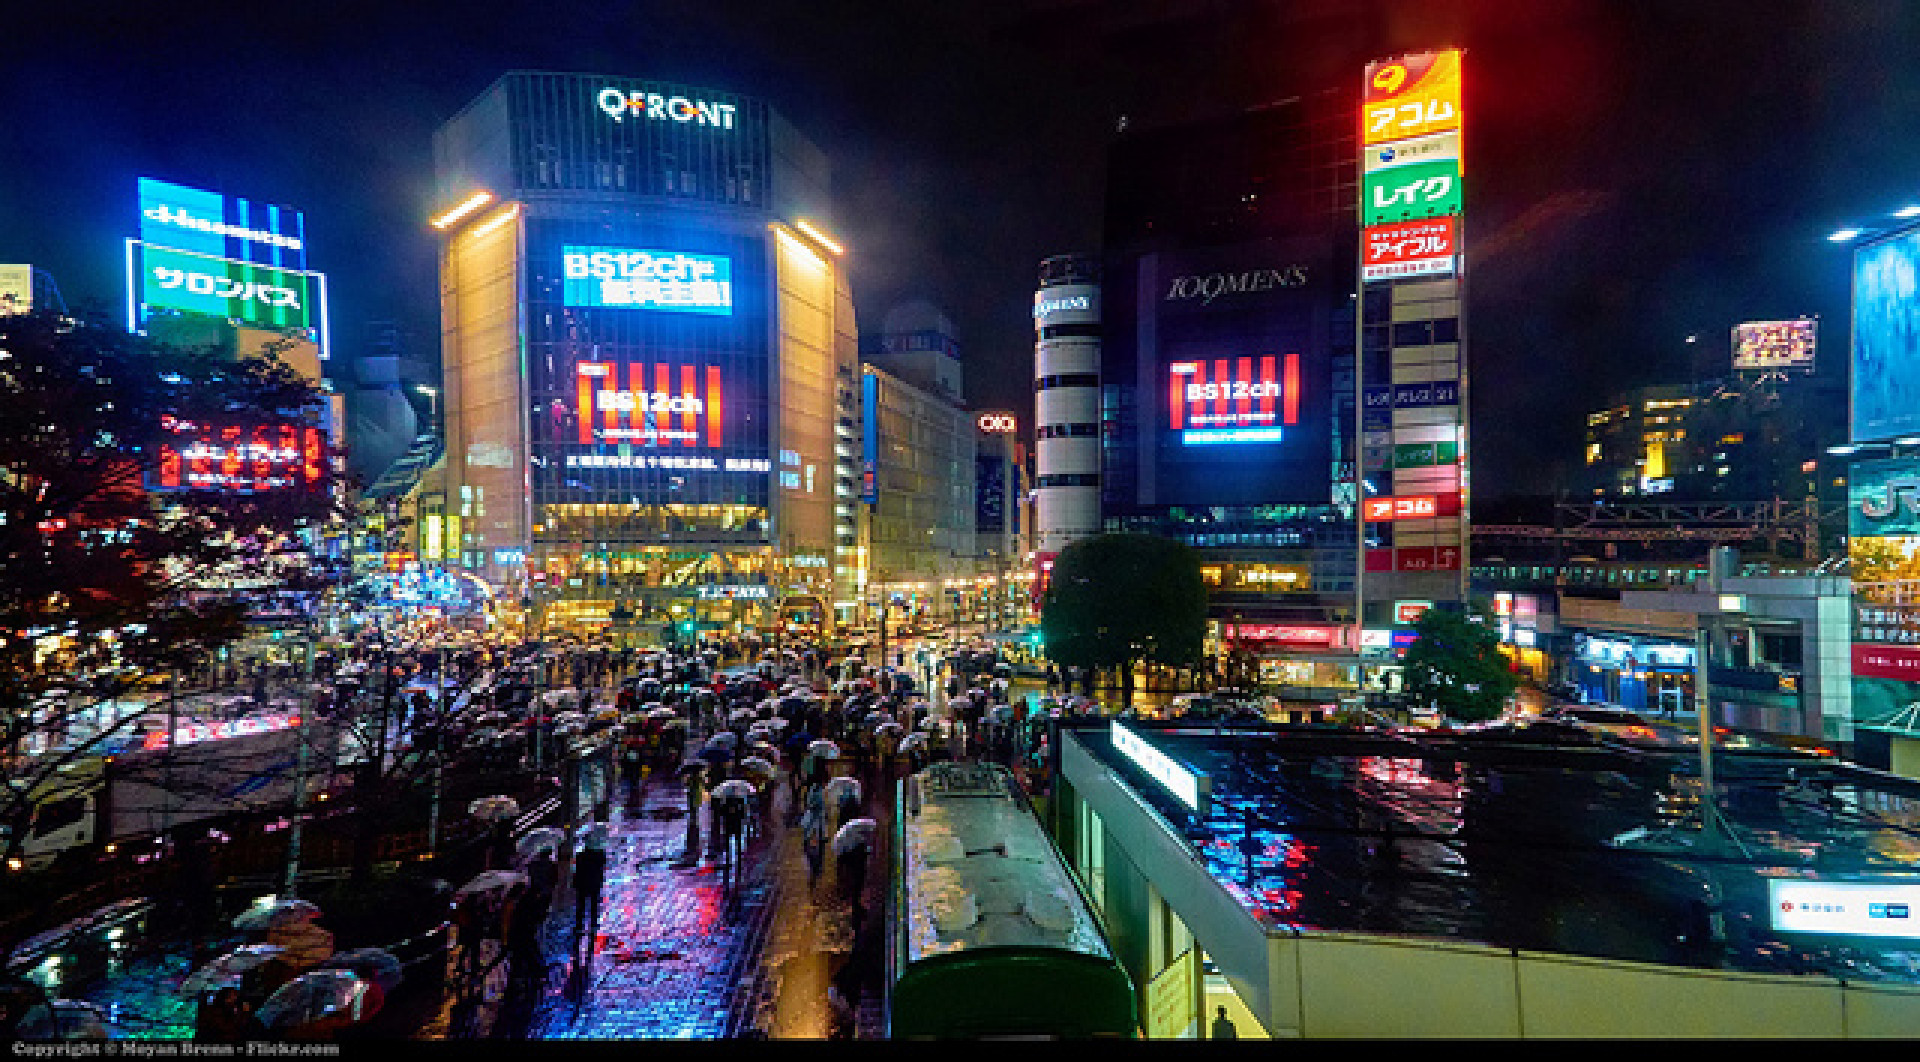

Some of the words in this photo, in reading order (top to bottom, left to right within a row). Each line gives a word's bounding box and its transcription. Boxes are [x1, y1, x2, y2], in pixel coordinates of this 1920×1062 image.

[597, 87, 736, 130] QFRONT
[1370, 98, 1453, 132] アコム
[1373, 176, 1453, 208] レイク
[1370, 236, 1450, 260] アイフル
[152, 265, 301, 310] サロンパス
[596, 388, 703, 413] BS12ch
[1186, 380, 1282, 402] BS12ch
[1373, 500, 1433, 517] アコム
